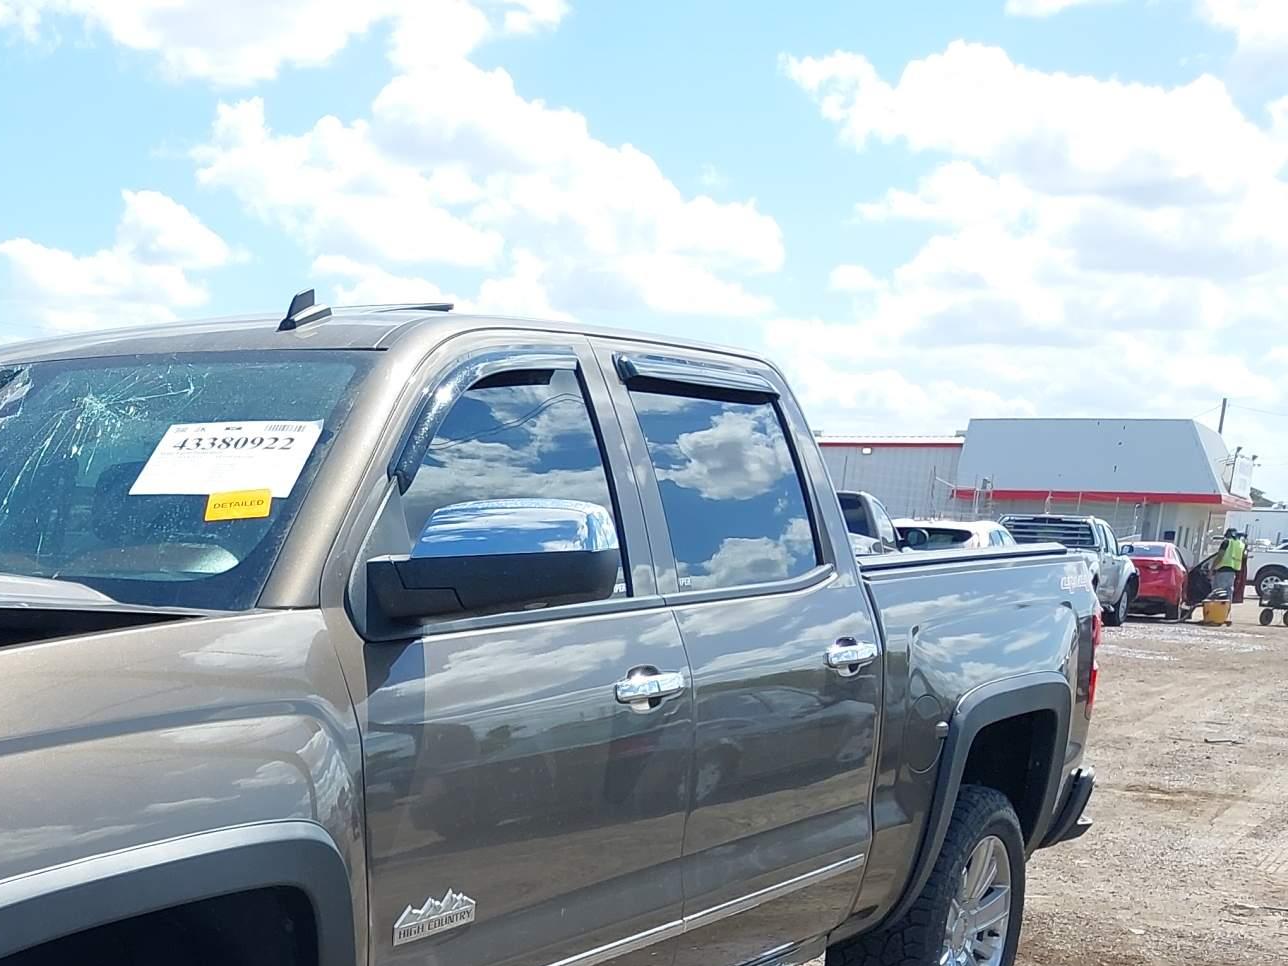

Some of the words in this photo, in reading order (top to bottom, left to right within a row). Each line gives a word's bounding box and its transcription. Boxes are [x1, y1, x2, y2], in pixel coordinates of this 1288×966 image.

[172, 436, 295, 451] 43380922
[212, 498, 265, 510] DETAILED
[398, 923, 425, 940] HIGH
[427, 908, 472, 931] COUNTRY
